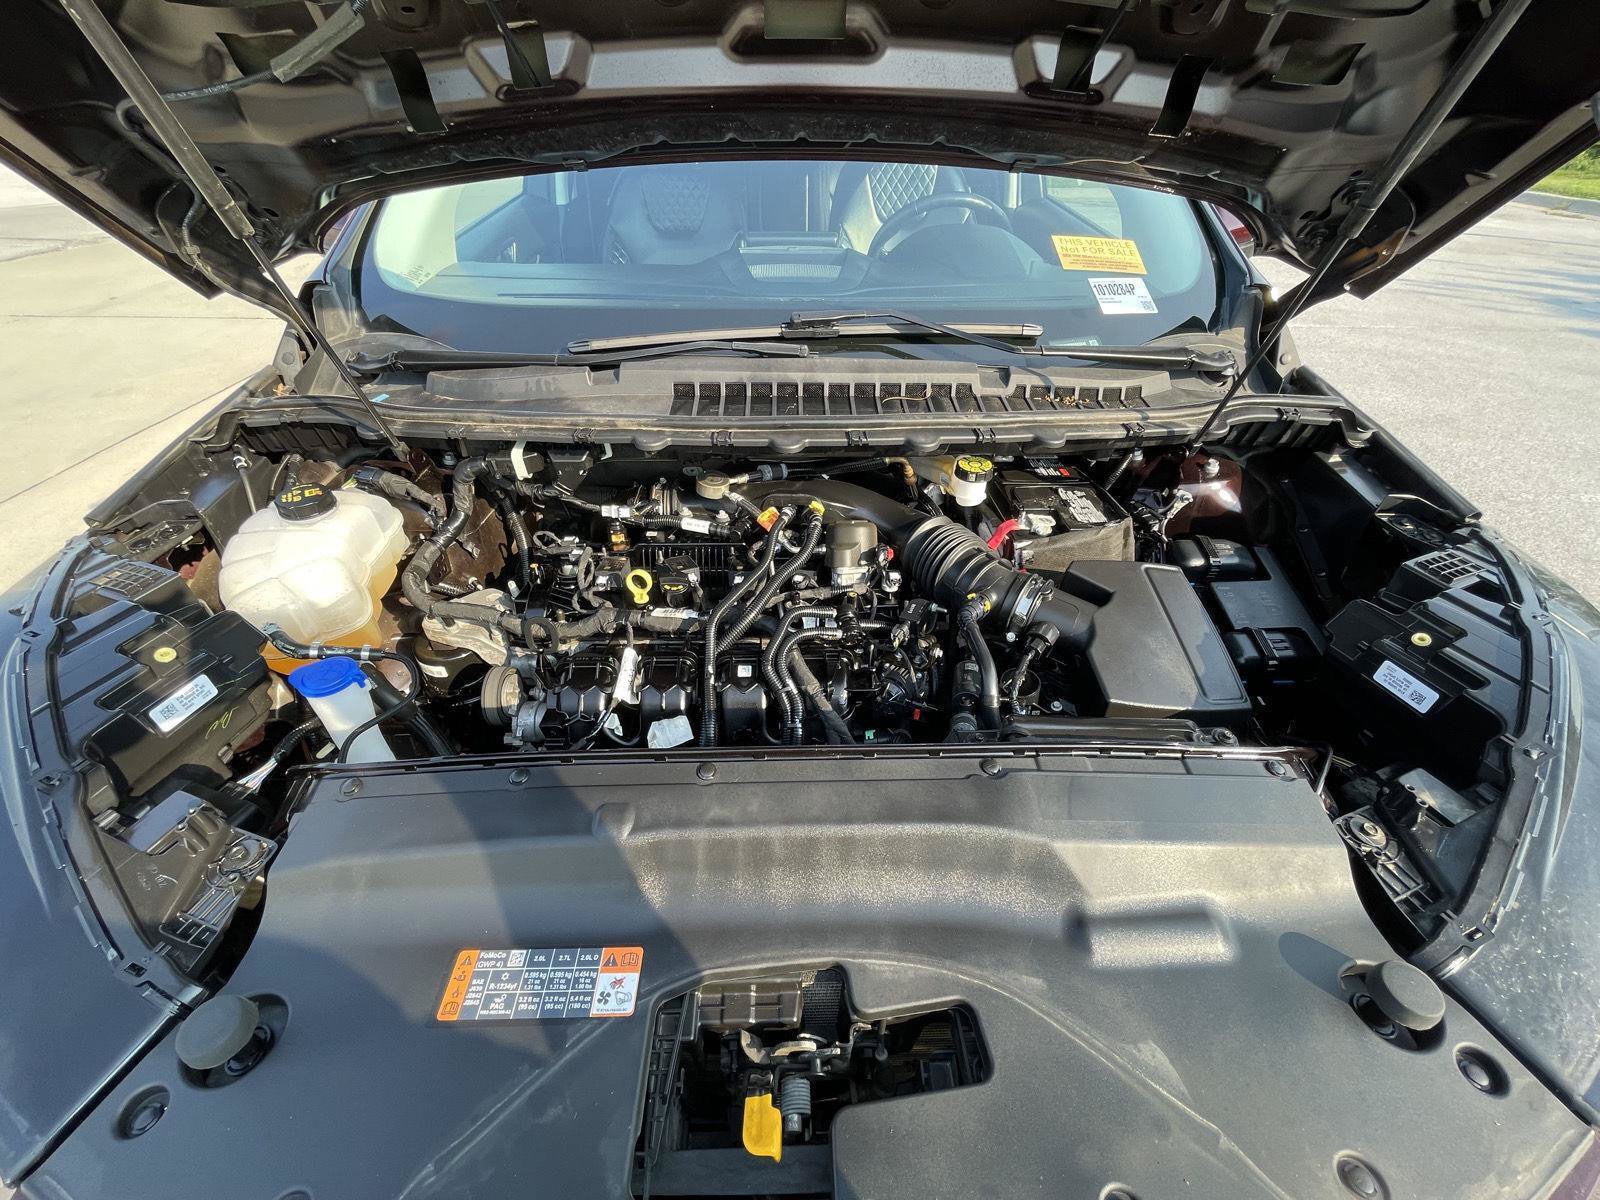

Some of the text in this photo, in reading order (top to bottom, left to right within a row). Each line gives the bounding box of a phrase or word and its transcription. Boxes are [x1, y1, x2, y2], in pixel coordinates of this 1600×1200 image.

[1059, 238, 1133, 249] THIS VEHICLE
[1108, 248, 1136, 257] SALE
[1093, 283, 1135, 296] 1010284P
